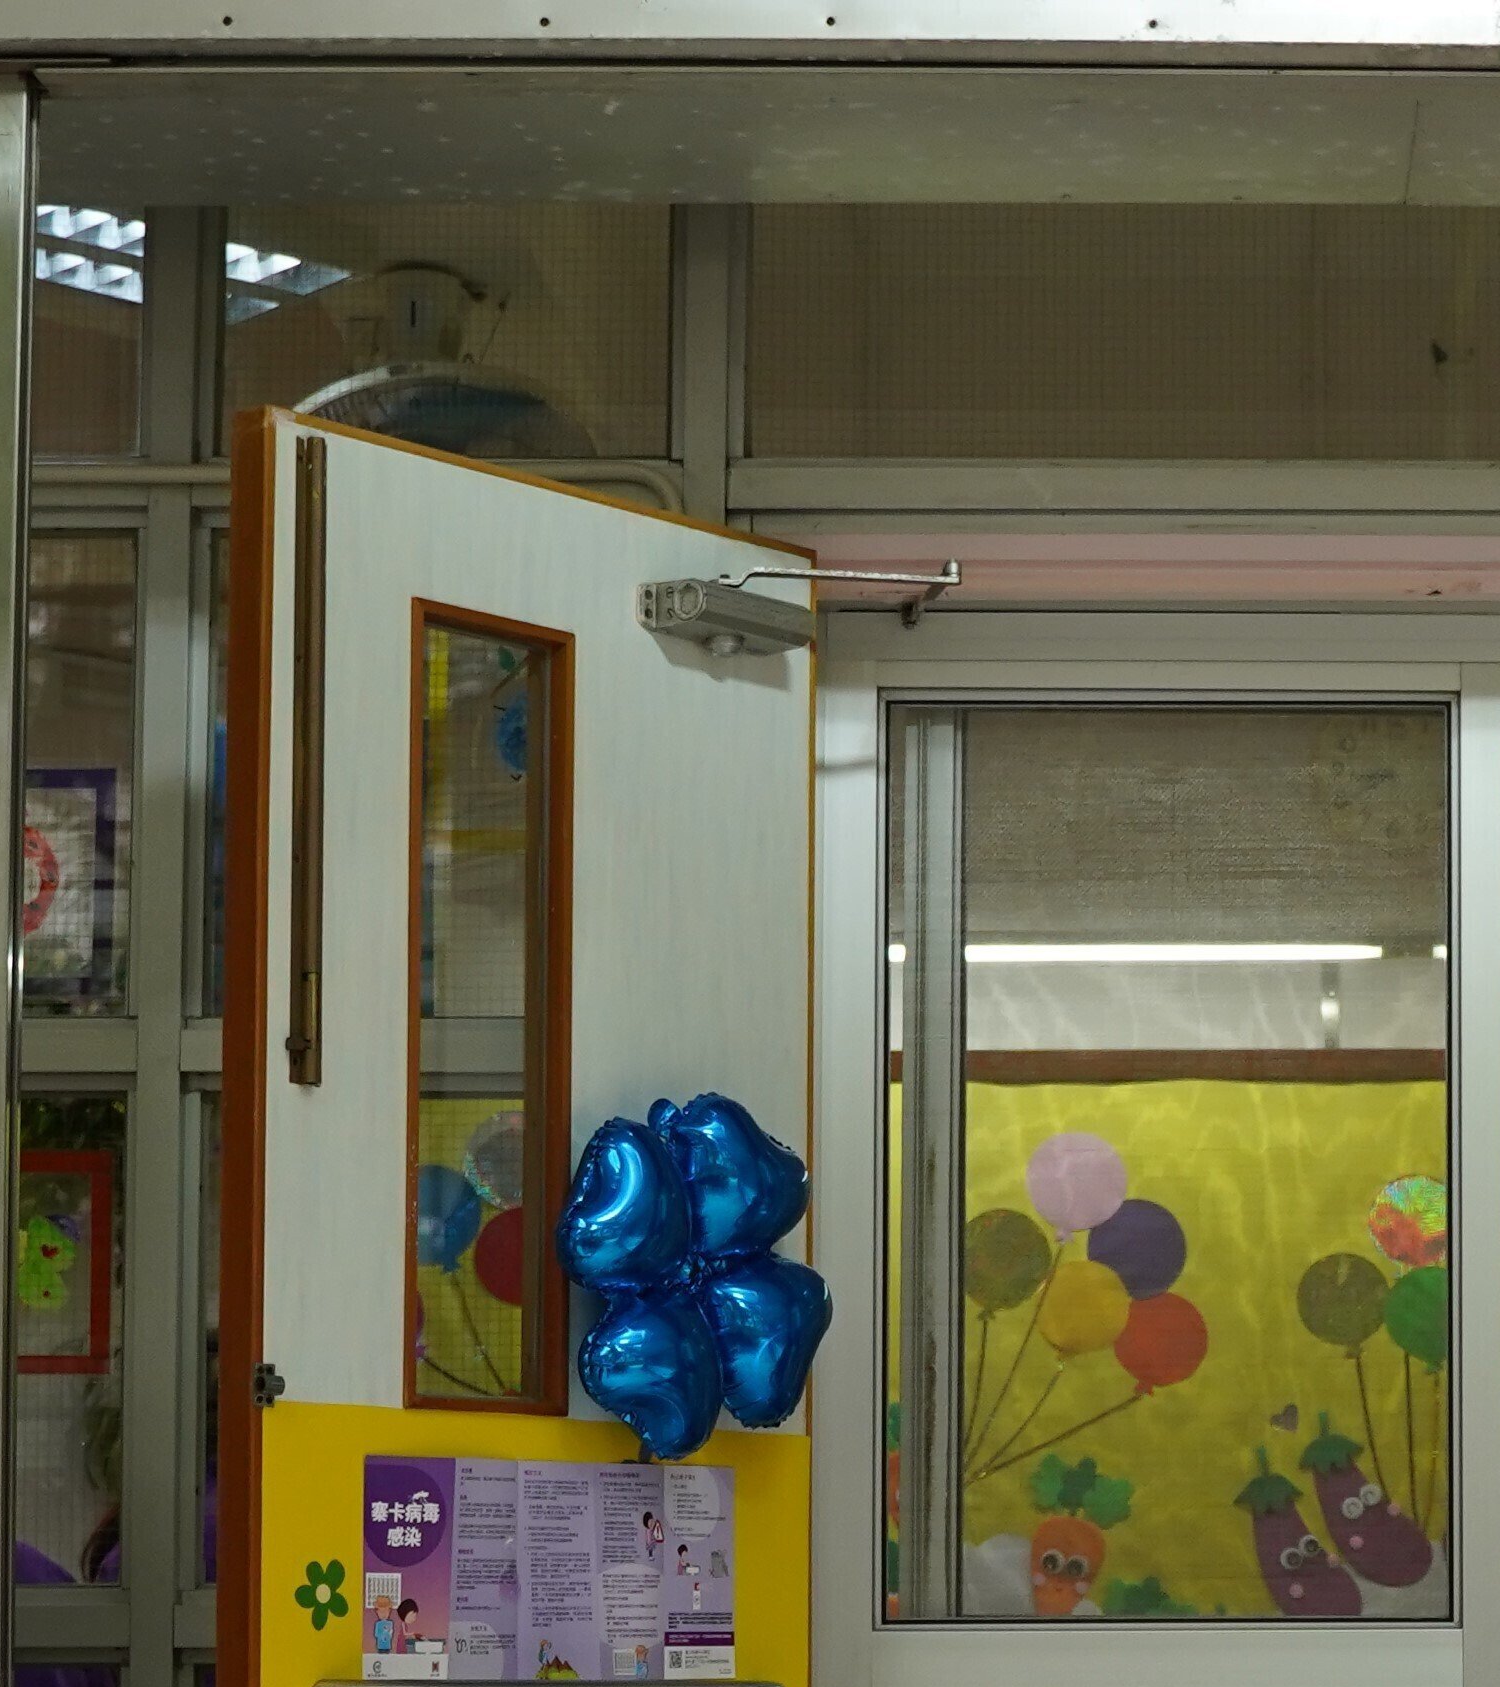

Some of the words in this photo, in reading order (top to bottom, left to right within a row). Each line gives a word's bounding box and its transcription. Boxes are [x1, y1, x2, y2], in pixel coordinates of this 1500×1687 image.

[371, 1501, 440, 1523] 寨卡病毒
[387, 1526, 422, 1548] 感染
